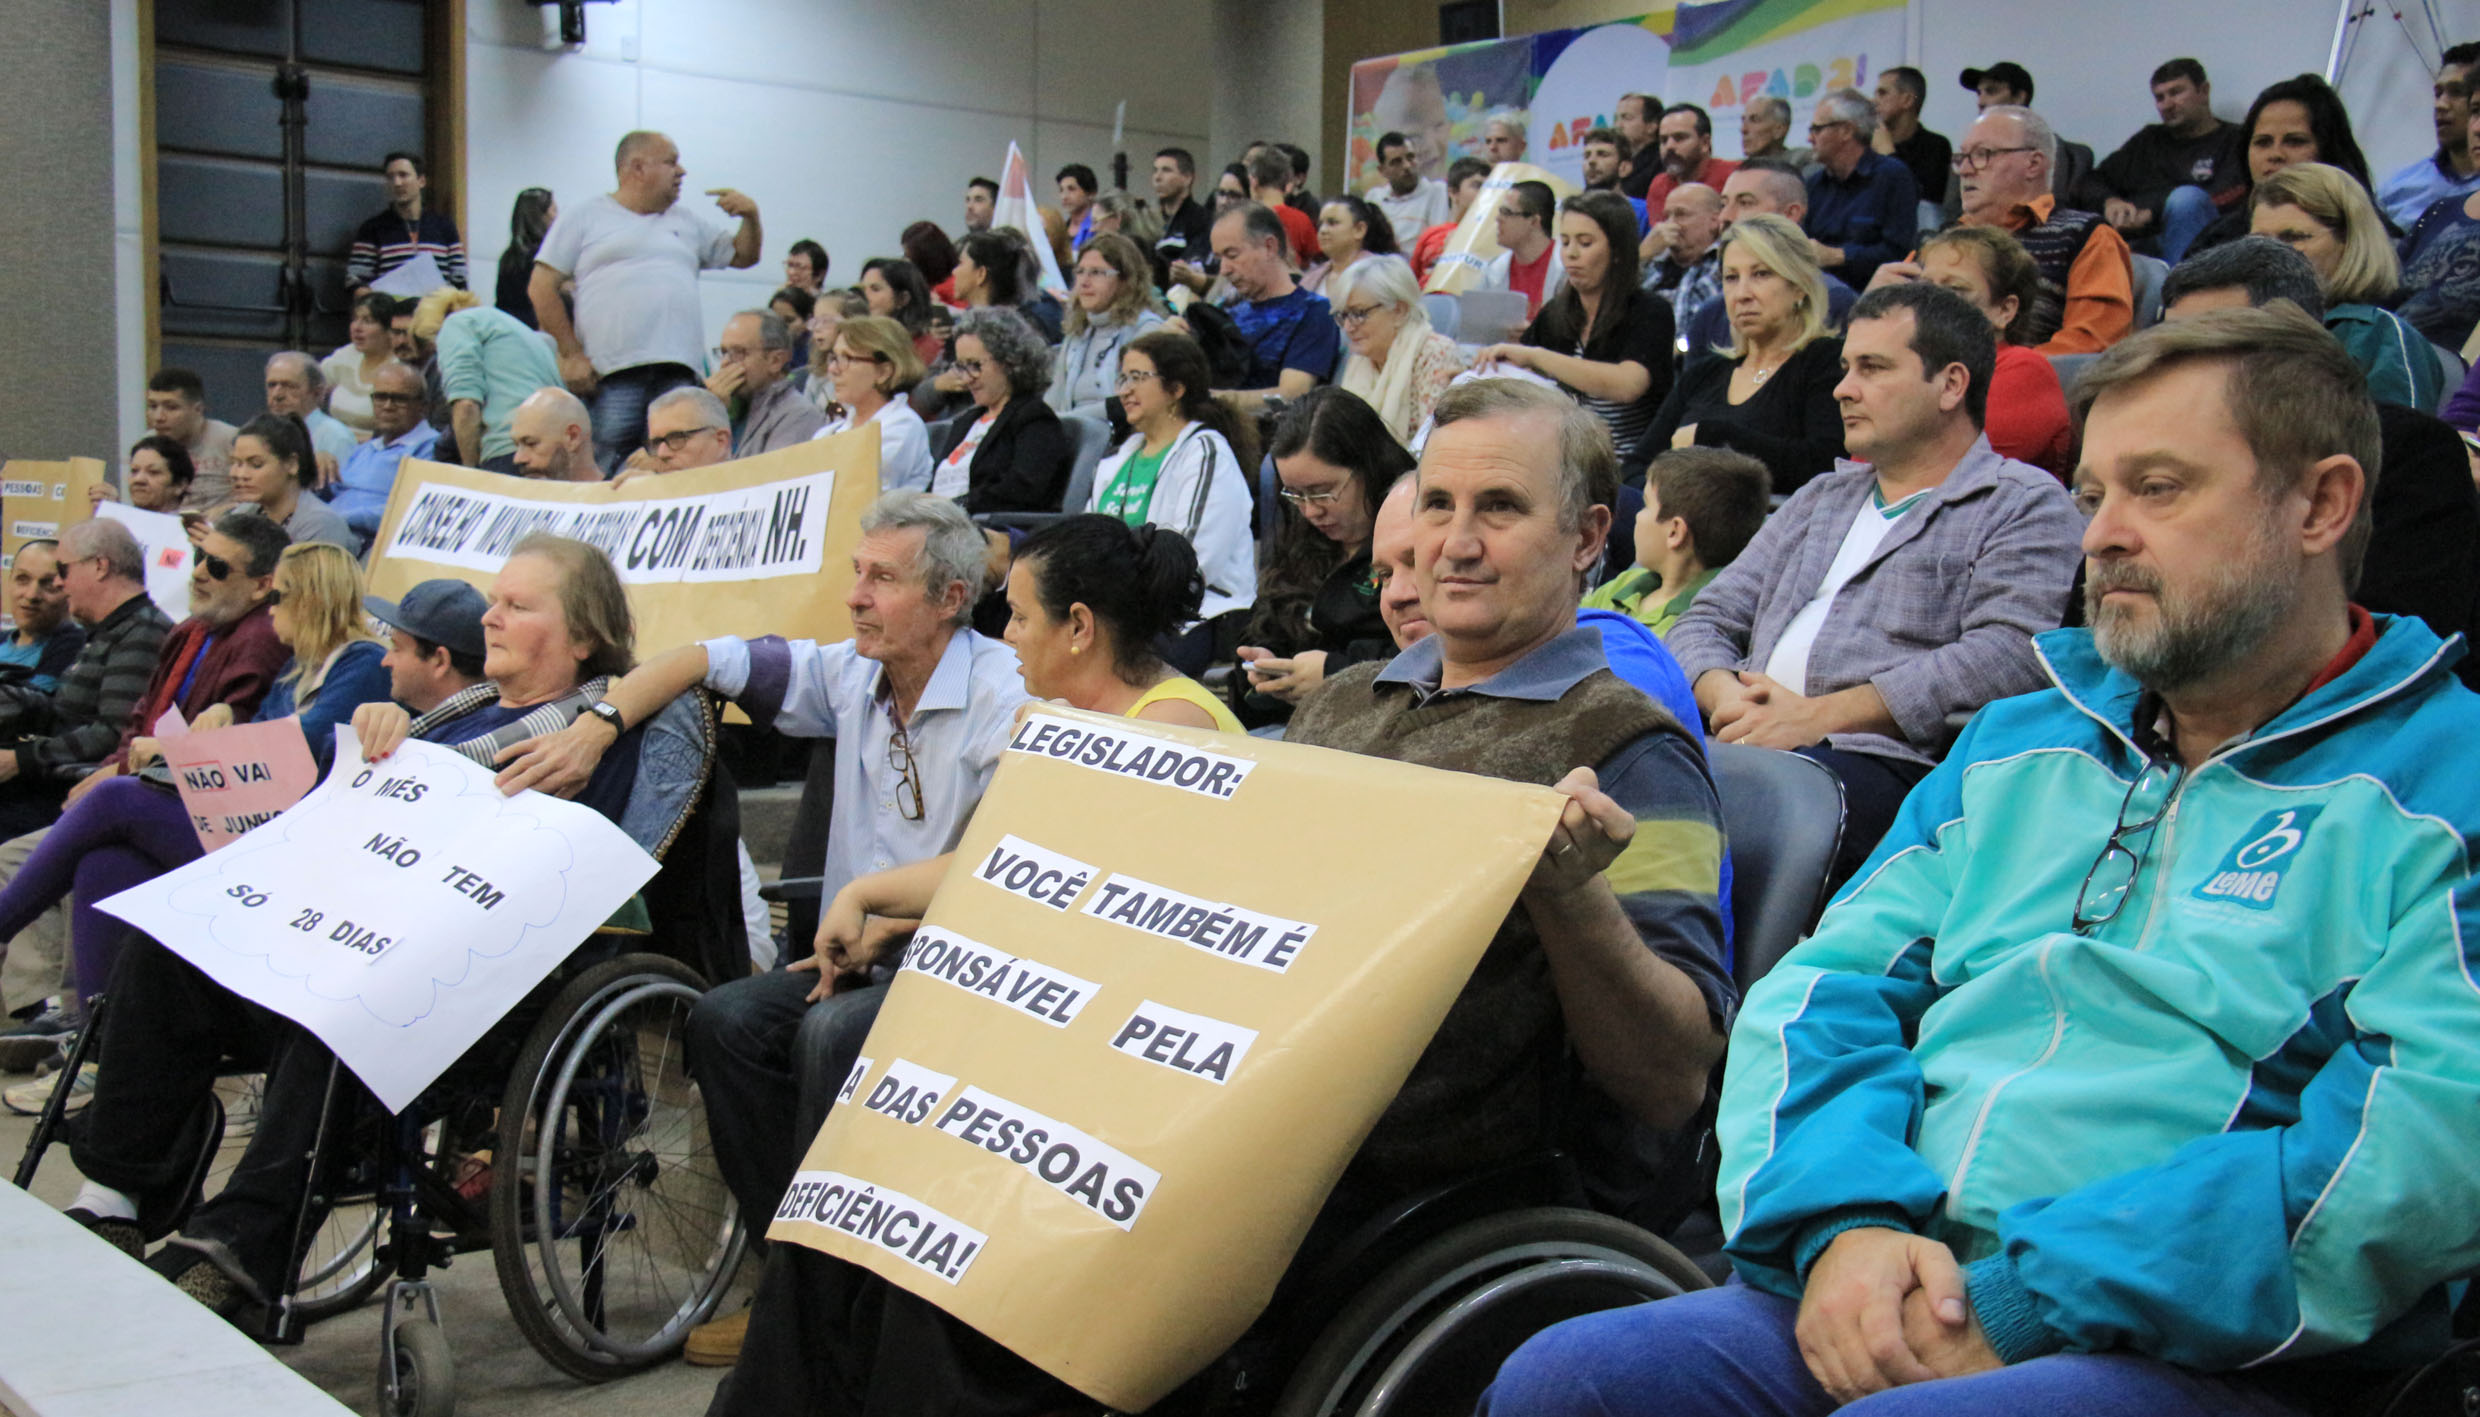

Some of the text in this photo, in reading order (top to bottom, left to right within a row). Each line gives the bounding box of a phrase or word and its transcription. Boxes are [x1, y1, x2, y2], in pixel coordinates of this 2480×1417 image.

[1549, 113, 1618, 150] AFA
[398, 492, 491, 553] CONSELHO
[627, 504, 707, 570] COM
[761, 485, 811, 565] NH.
[184, 762, 273, 790] NÃO VAI
[351, 769, 429, 802] O MÊS
[1009, 721, 1244, 797] LEGISLADOR:
[362, 833, 506, 911] NÃO TEM
[982, 847, 1307, 968] VOCÊ TAMBÉM É
[226, 883, 392, 956] SÓ 28 DIAS
[1112, 1014, 1236, 1082] PELA
[864, 1075, 938, 1125] DAS
[936, 1097, 1145, 1222] PESSOAS
[776, 1181, 978, 1280] DEFICIÊNCIA!
